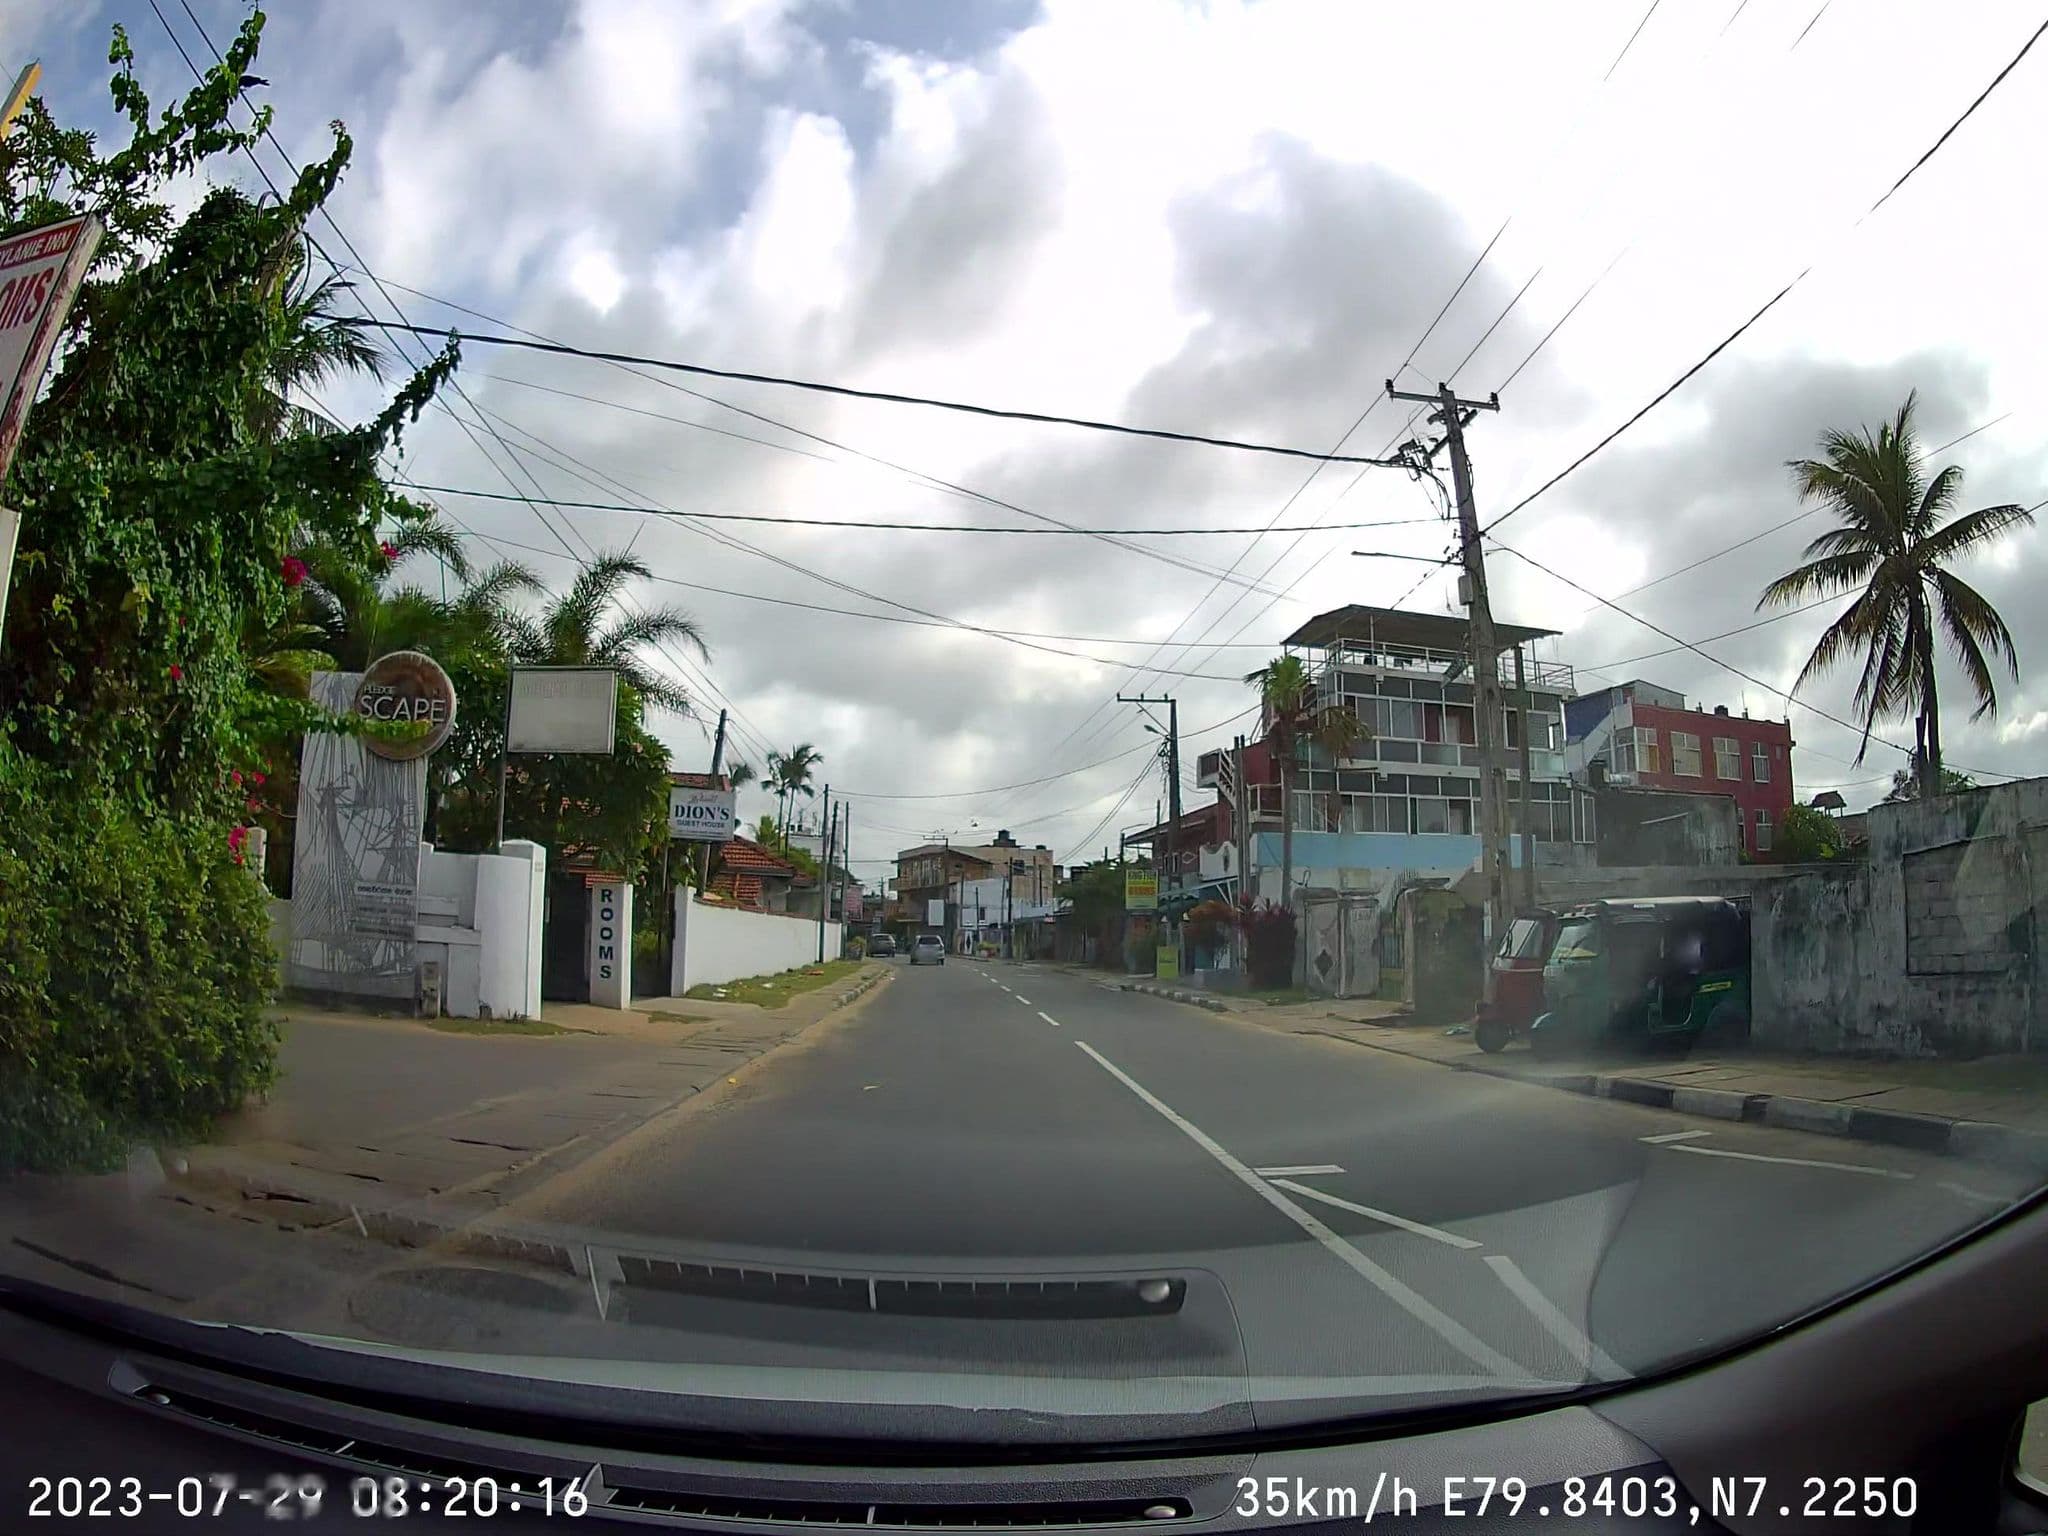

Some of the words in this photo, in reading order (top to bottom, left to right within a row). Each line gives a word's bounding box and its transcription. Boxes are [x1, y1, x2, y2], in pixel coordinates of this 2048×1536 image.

[0, 238, 45, 267] YLANIE
[43, 228, 73, 254] INN
[358, 694, 446, 722] SCAPE
[674, 804, 731, 821] DION'S
[598, 888, 614, 979] ROOMS
